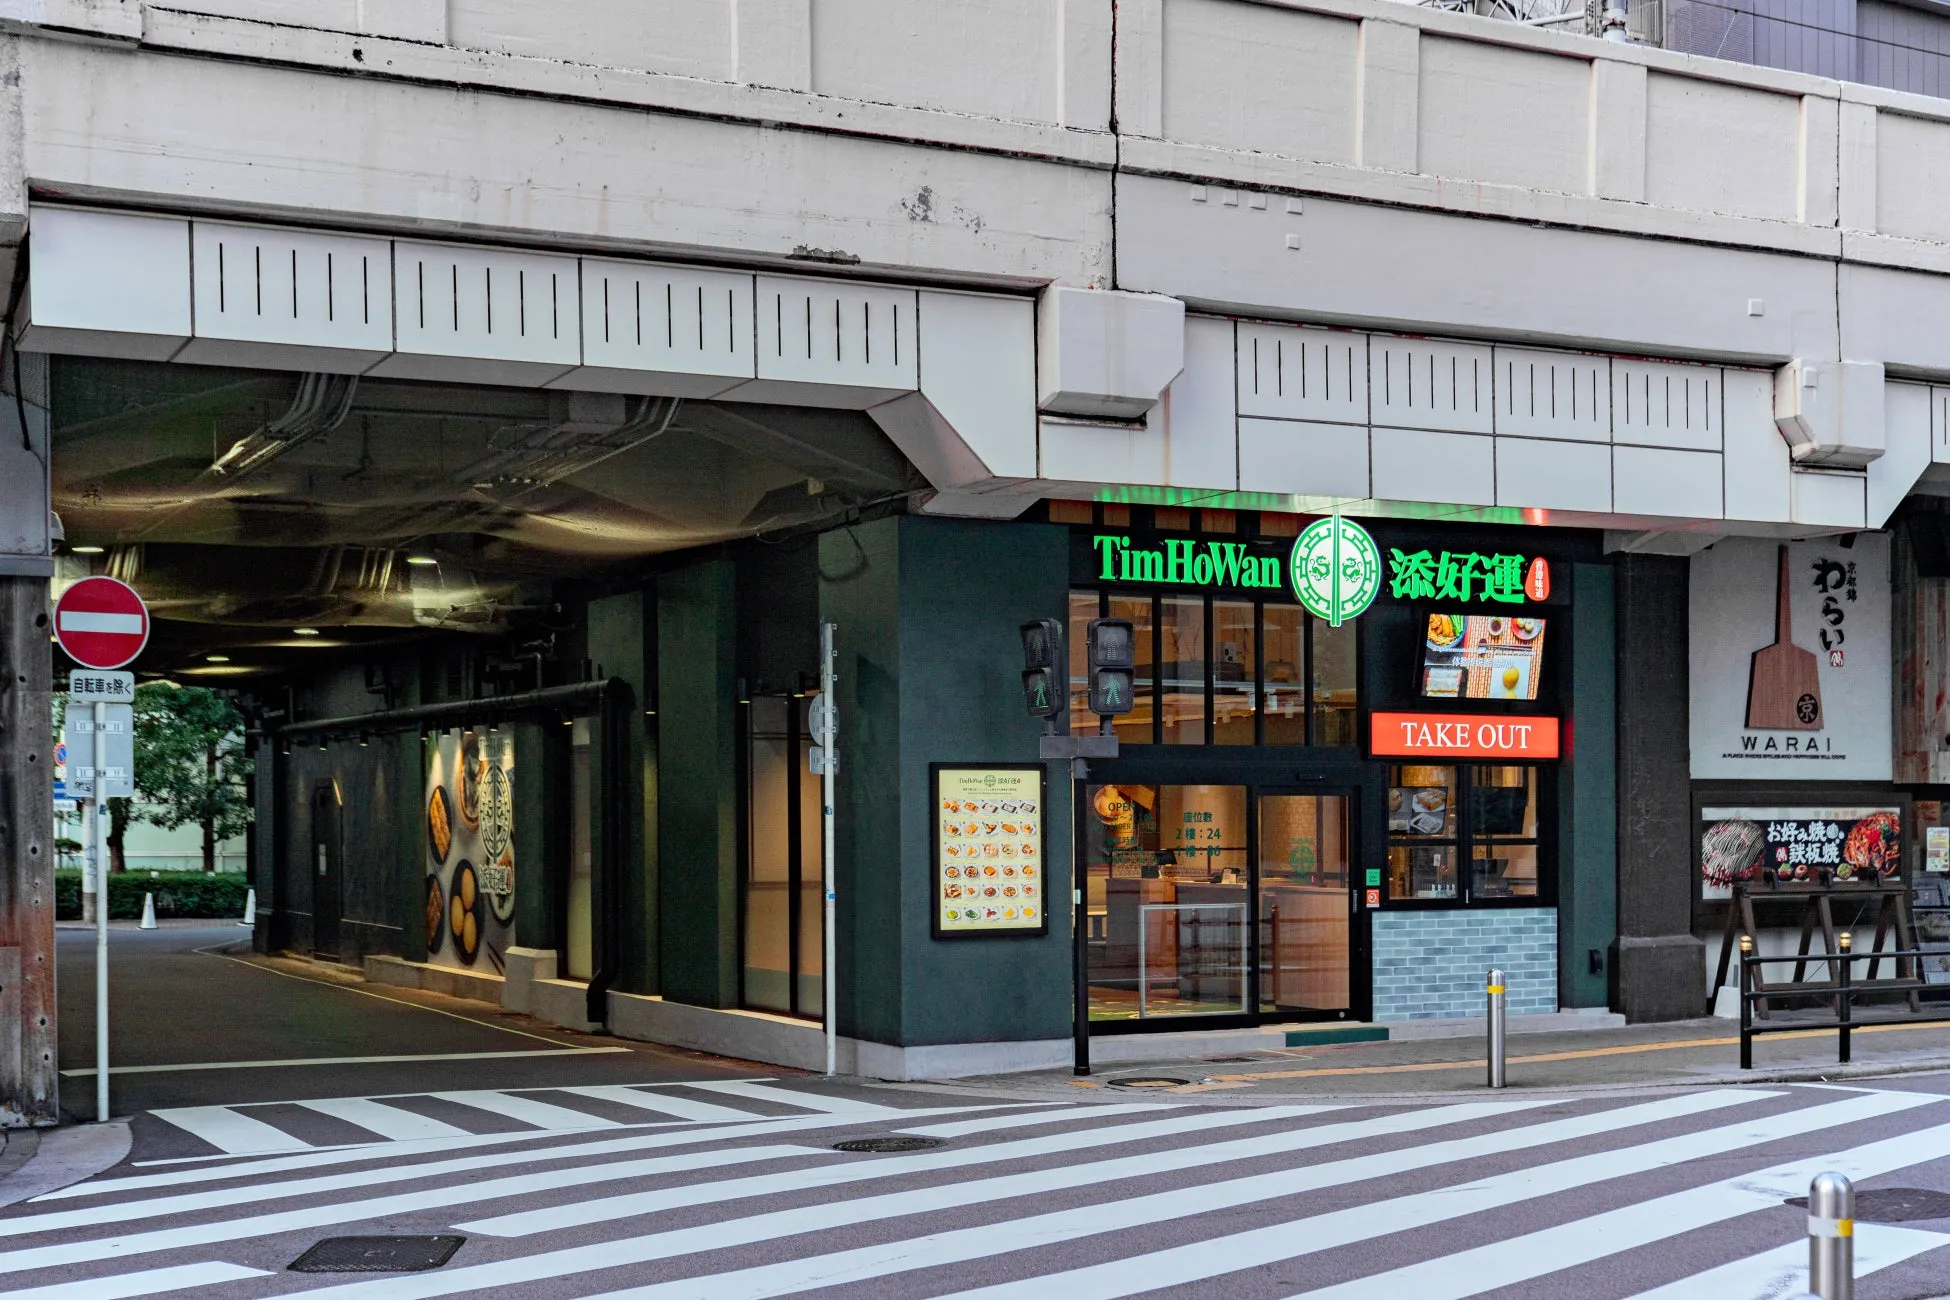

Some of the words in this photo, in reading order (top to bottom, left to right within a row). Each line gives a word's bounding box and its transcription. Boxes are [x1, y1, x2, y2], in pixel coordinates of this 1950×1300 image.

[1389, 547, 1525, 604] 添好運
[1811, 557, 1846, 652] わらい
[74, 677, 131, 695] 自転車を除く
[1400, 721, 1471, 748] TAKE
[1477, 723, 1532, 749] OUT
[1741, 735, 1831, 752] WARAI
[1766, 821, 1828, 843] お好み焼
[1788, 842, 1840, 864] 鉄板焼
